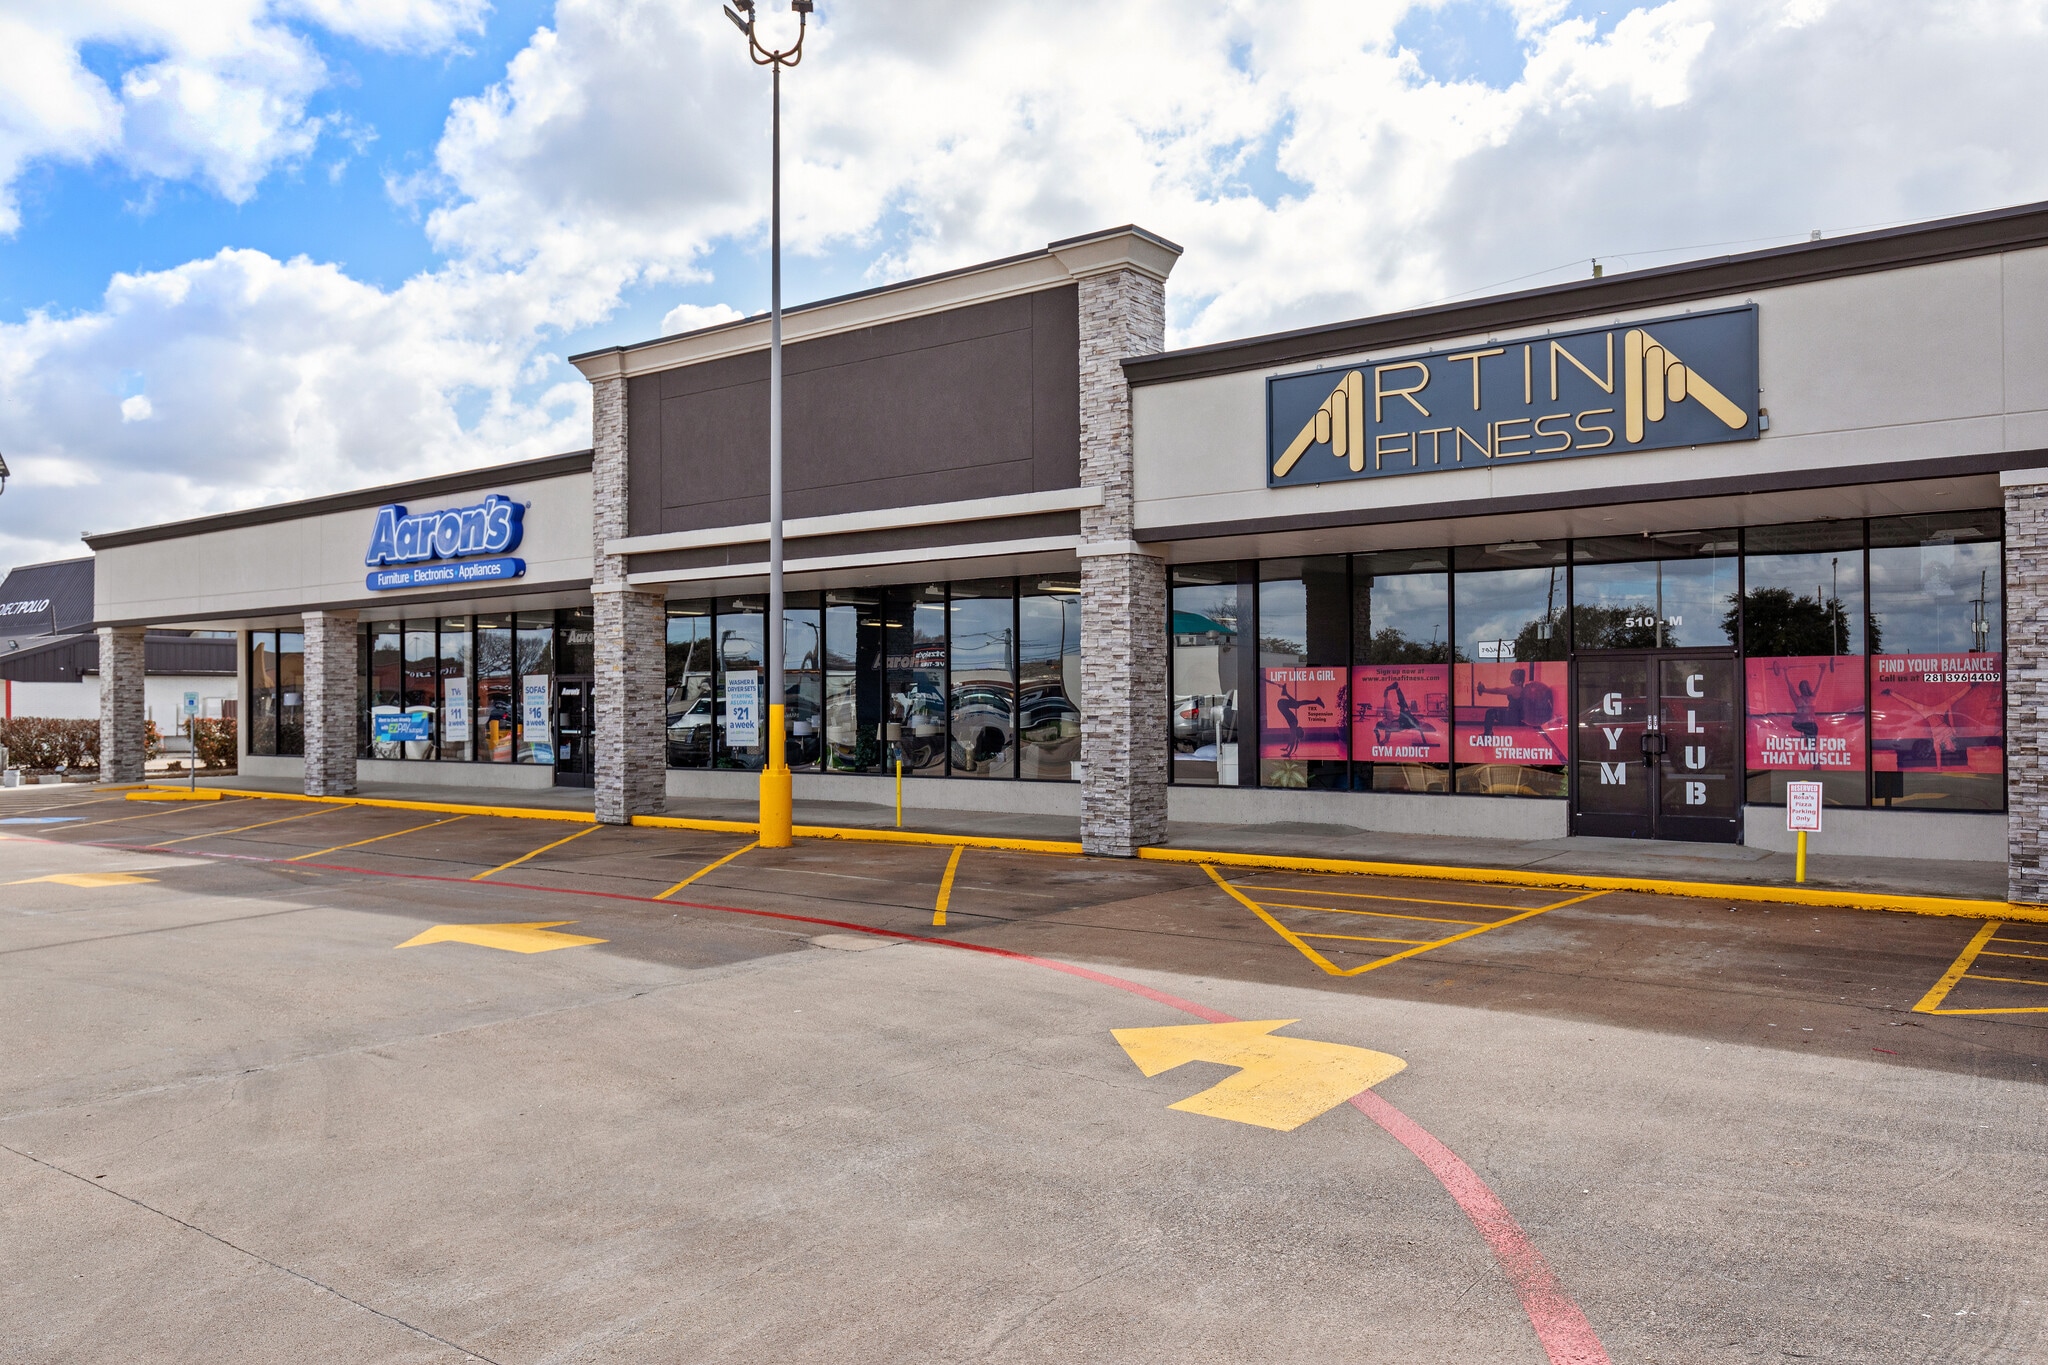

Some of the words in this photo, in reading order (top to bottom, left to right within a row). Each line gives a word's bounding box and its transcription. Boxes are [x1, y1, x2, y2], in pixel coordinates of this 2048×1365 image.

[1376, 407, 1615, 470] FITNESS
[366, 497, 513, 565] Aaron's
[378, 572, 410, 586] Furniture
[414, 567, 454, 582] Electronics
[459, 563, 501, 580] Appliances
[1625, 616, 1654, 628] 510
[1669, 616, 1683, 626] M
[567, 629, 595, 645] Aaro
[1879, 659, 1905, 672] FIND
[1907, 658, 1938, 672] YOUR
[1941, 657, 1993, 671] BALANCE
[1270, 672, 1288, 681] LIFT
[1289, 671, 1307, 681] LIKE
[1309, 670, 1315, 681] A
[1317, 670, 1336, 681] GIRL
[1925, 673, 1943, 682] 281
[1946, 673, 1968, 682] 396
[1970, 673, 2000, 682] 4409
[451, 709, 462, 719] $11
[529, 707, 542, 718] $16
[734, 707, 749, 720] $21
[1469, 735, 1513, 747] CARDIO
[1766, 738, 1816, 750] HUSTLE
[1819, 738, 1846, 750] FOR
[1372, 745, 1393, 757] GYM
[1395, 746, 1430, 758] ADDICT
[1495, 748, 1553, 760] STRENGTH
[1761, 751, 1795, 764] THAT
[1798, 752, 1851, 765] MUSCLE
